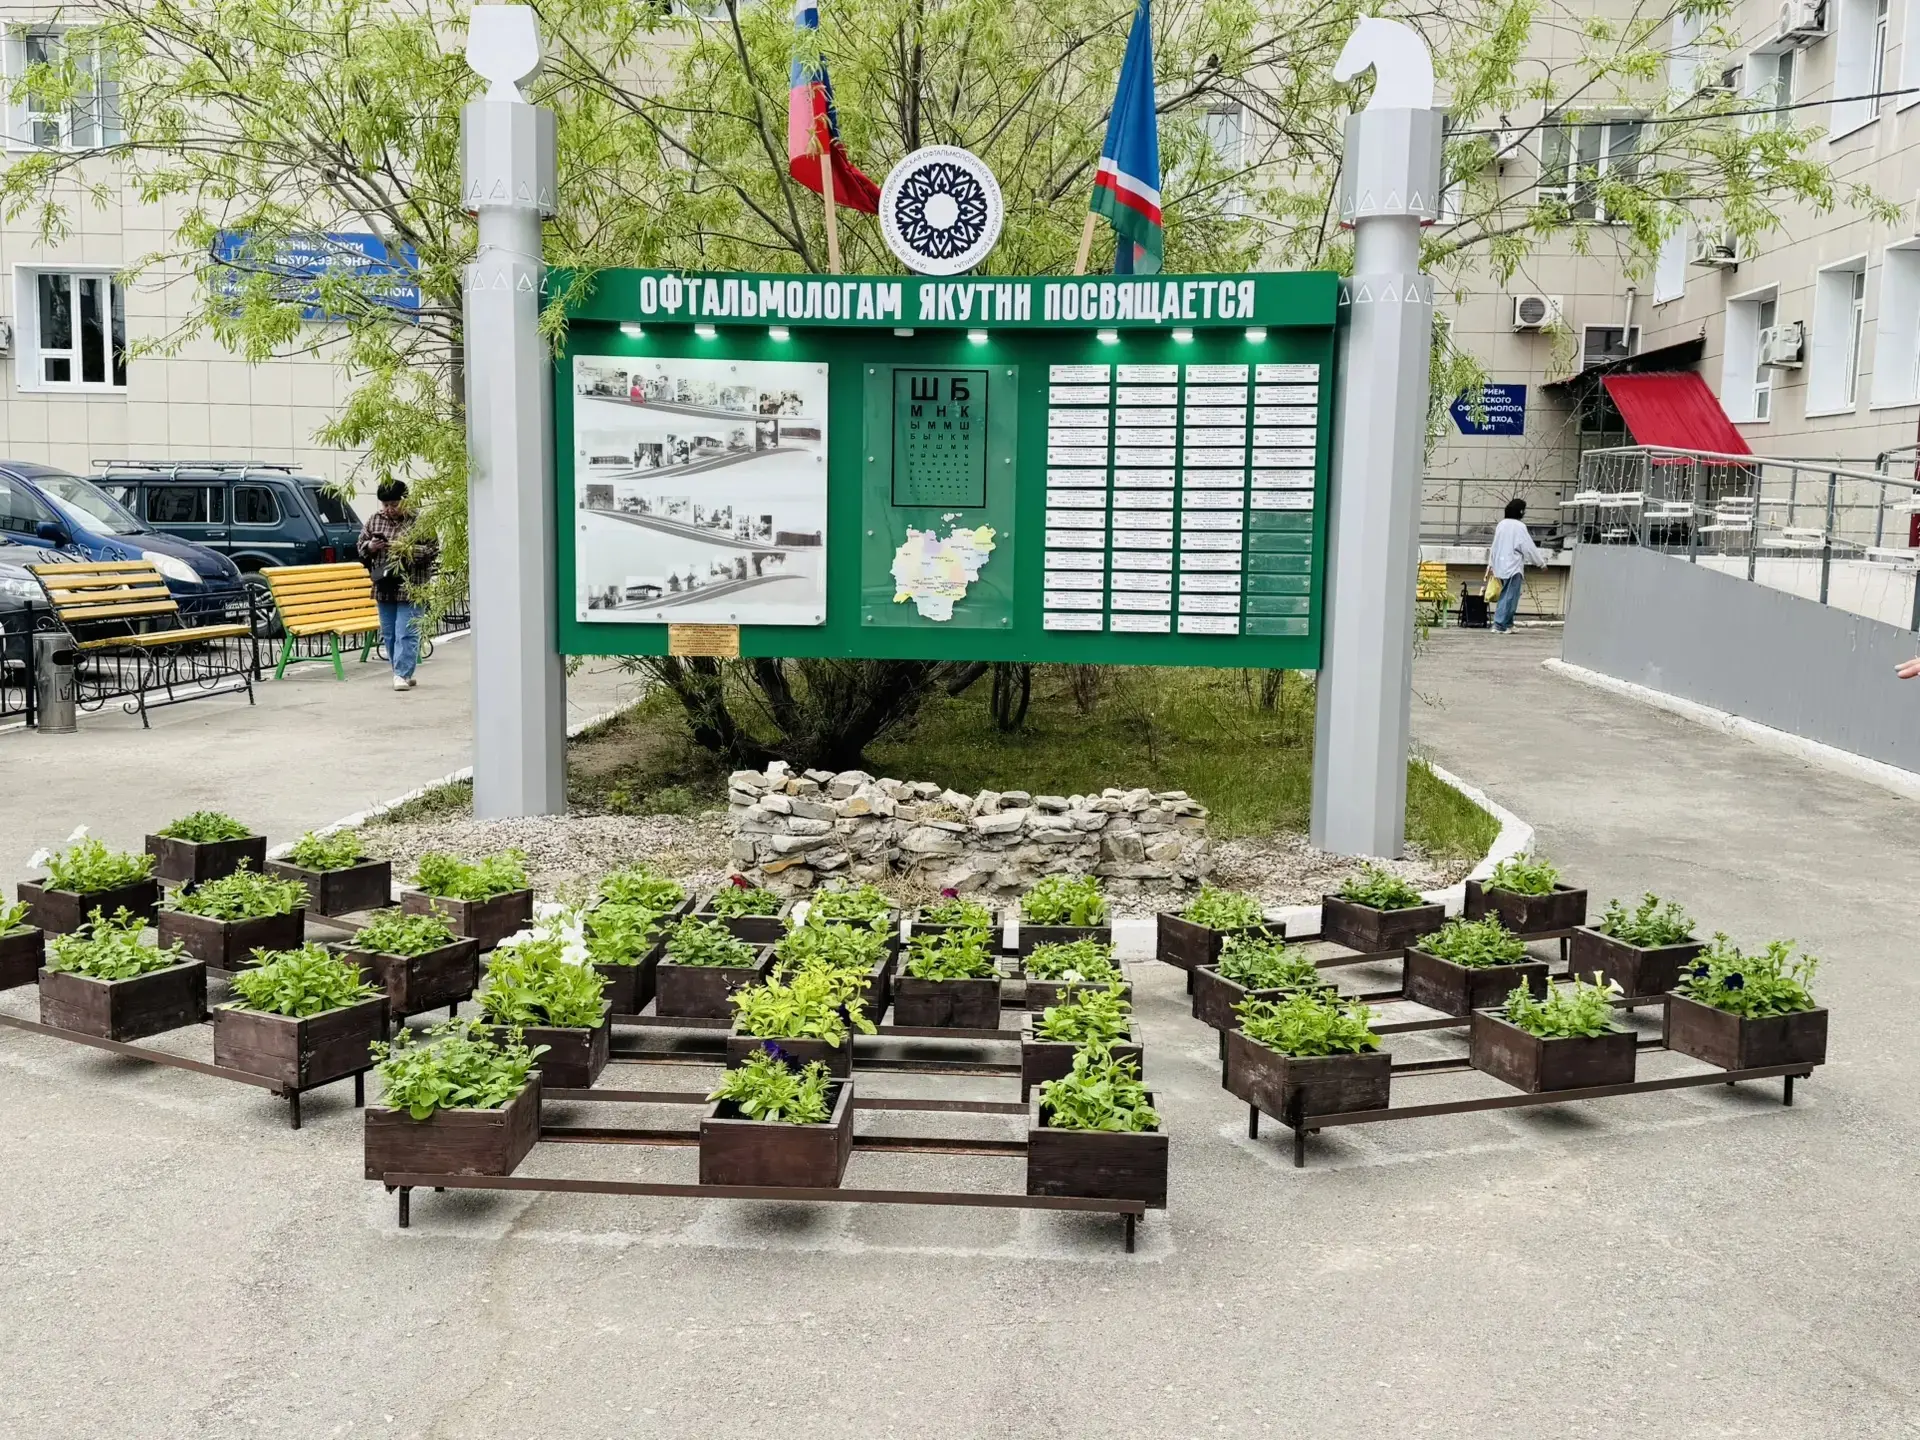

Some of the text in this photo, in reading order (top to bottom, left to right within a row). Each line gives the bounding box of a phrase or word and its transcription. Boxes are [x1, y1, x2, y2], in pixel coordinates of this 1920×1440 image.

[640, 273, 1255, 323] ОФТАЛЬМОЛОГАМ ЯКУТИИ ПОСВЯЩАЕТСЯ
[911, 376, 970, 400] Ш Б
[911, 405, 969, 417] М Н К
